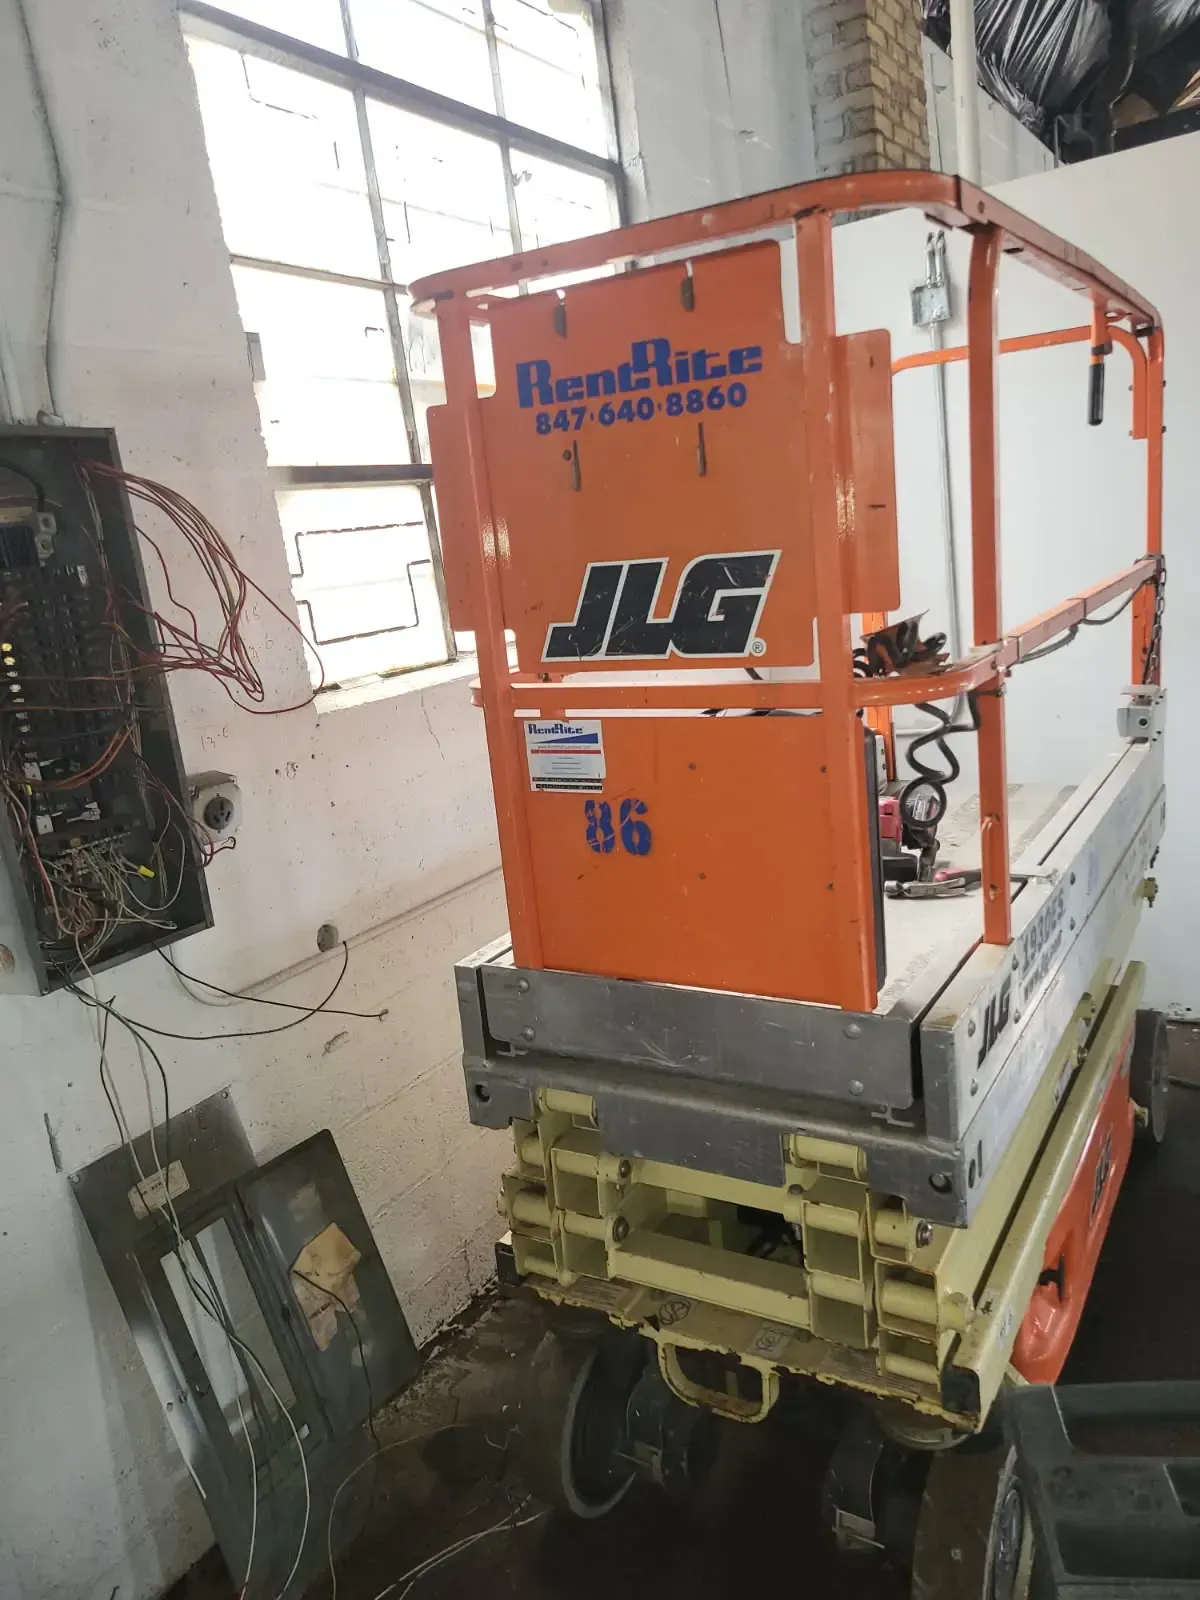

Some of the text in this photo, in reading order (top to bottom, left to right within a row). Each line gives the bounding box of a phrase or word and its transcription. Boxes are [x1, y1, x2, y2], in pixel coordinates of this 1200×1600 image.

[516, 337, 763, 408] RentRite
[528, 724, 583, 734] RentRite
[584, 799, 651, 856] 86
